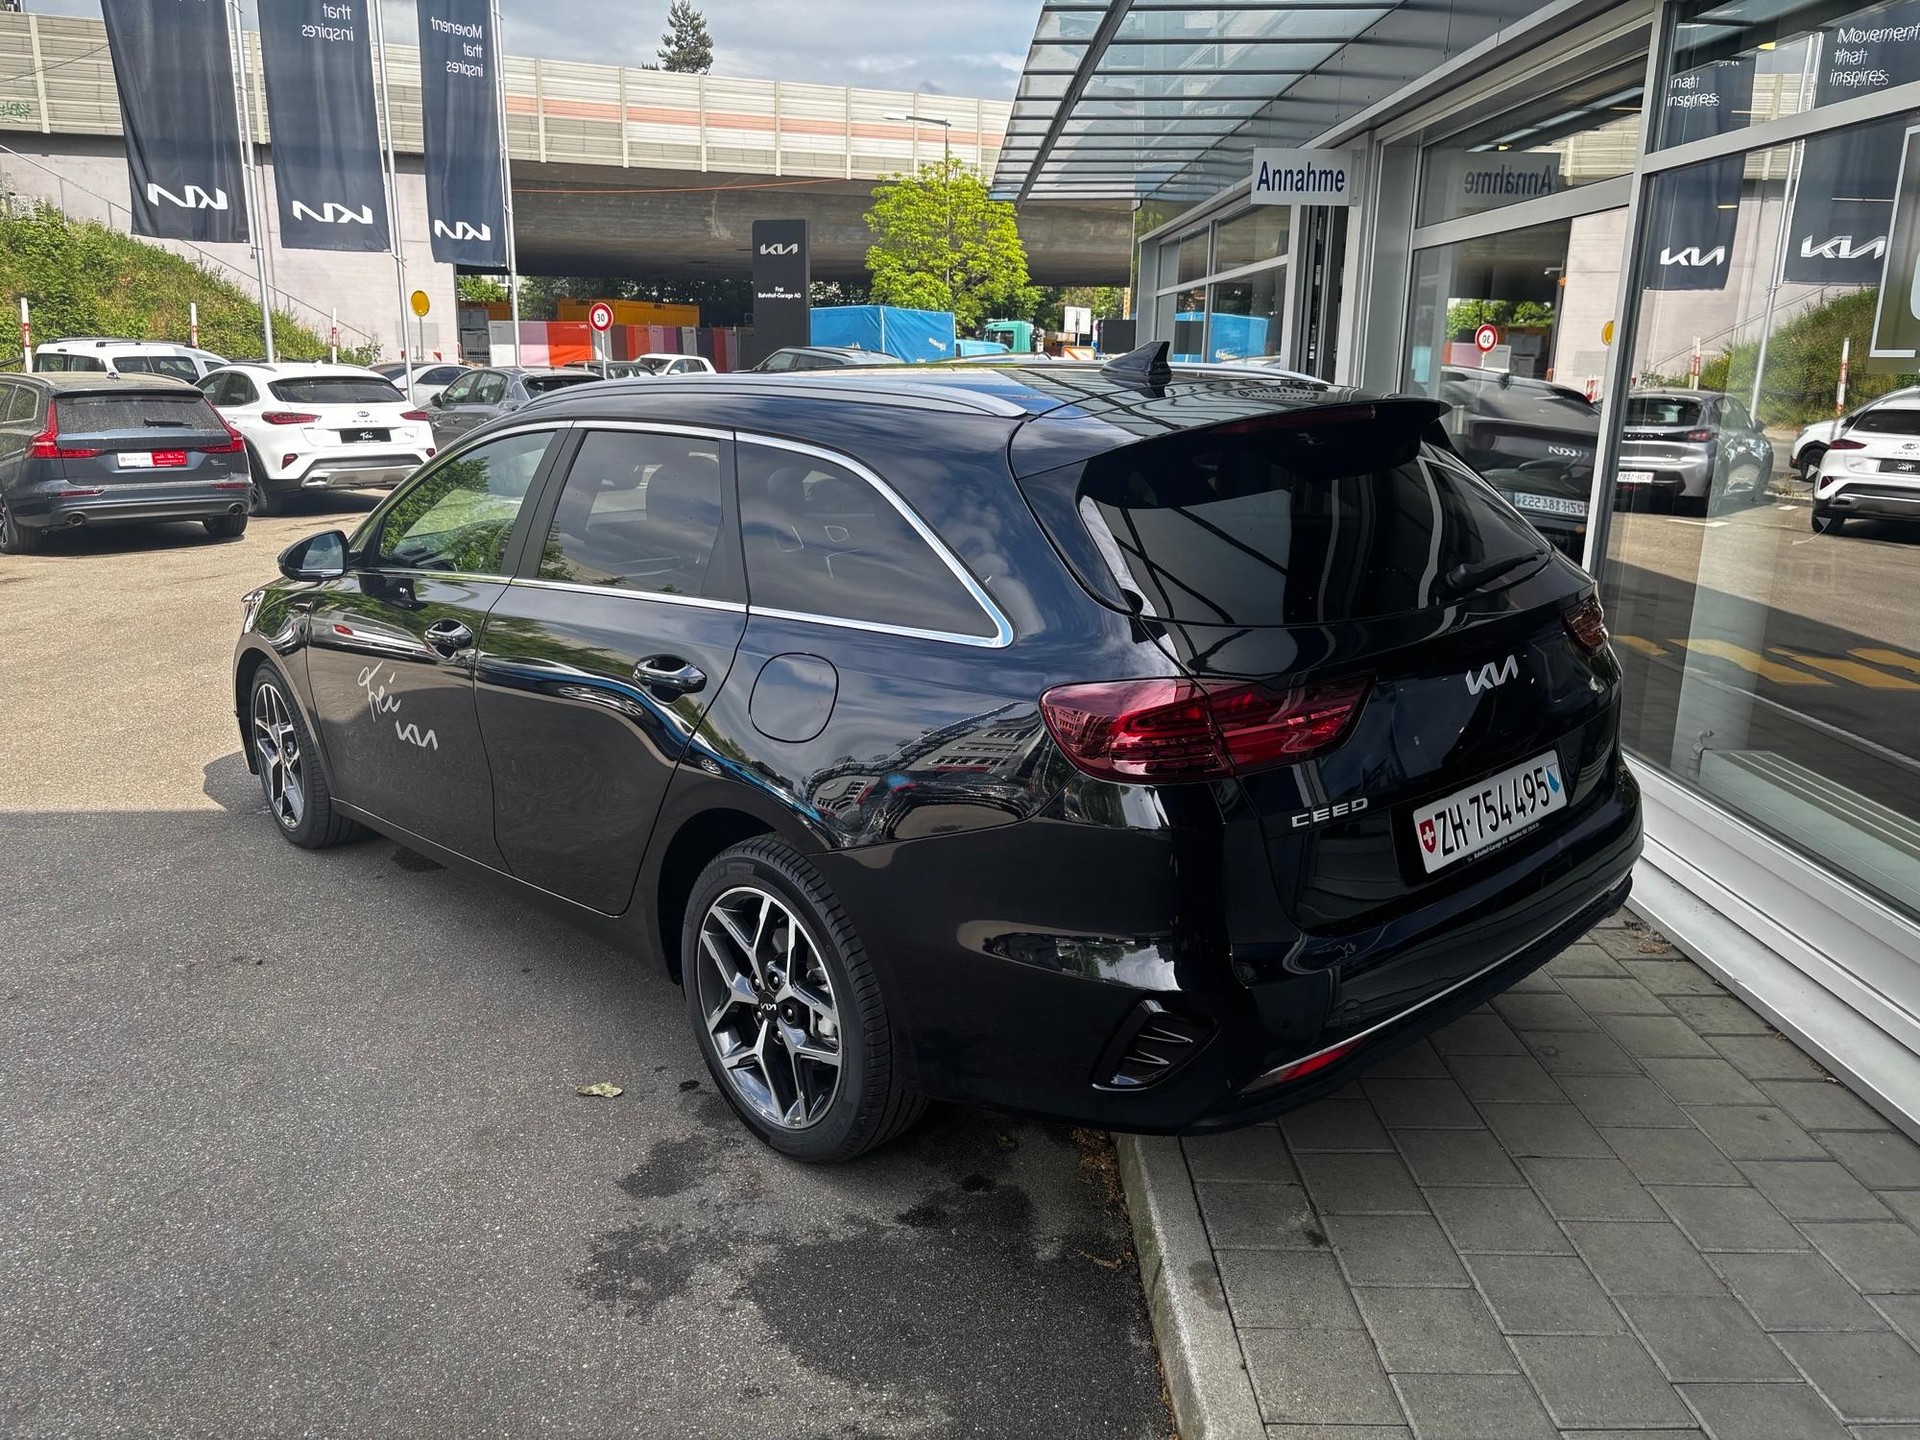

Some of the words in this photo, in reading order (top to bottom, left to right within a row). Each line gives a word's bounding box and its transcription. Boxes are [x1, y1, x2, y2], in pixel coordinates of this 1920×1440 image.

[1256, 160, 1345, 193] Annahme
[760, 243, 798, 255] KIA
[596, 313, 605, 322] 30
[1465, 654, 1519, 695] KIA
[1291, 797, 1368, 828] CEED
